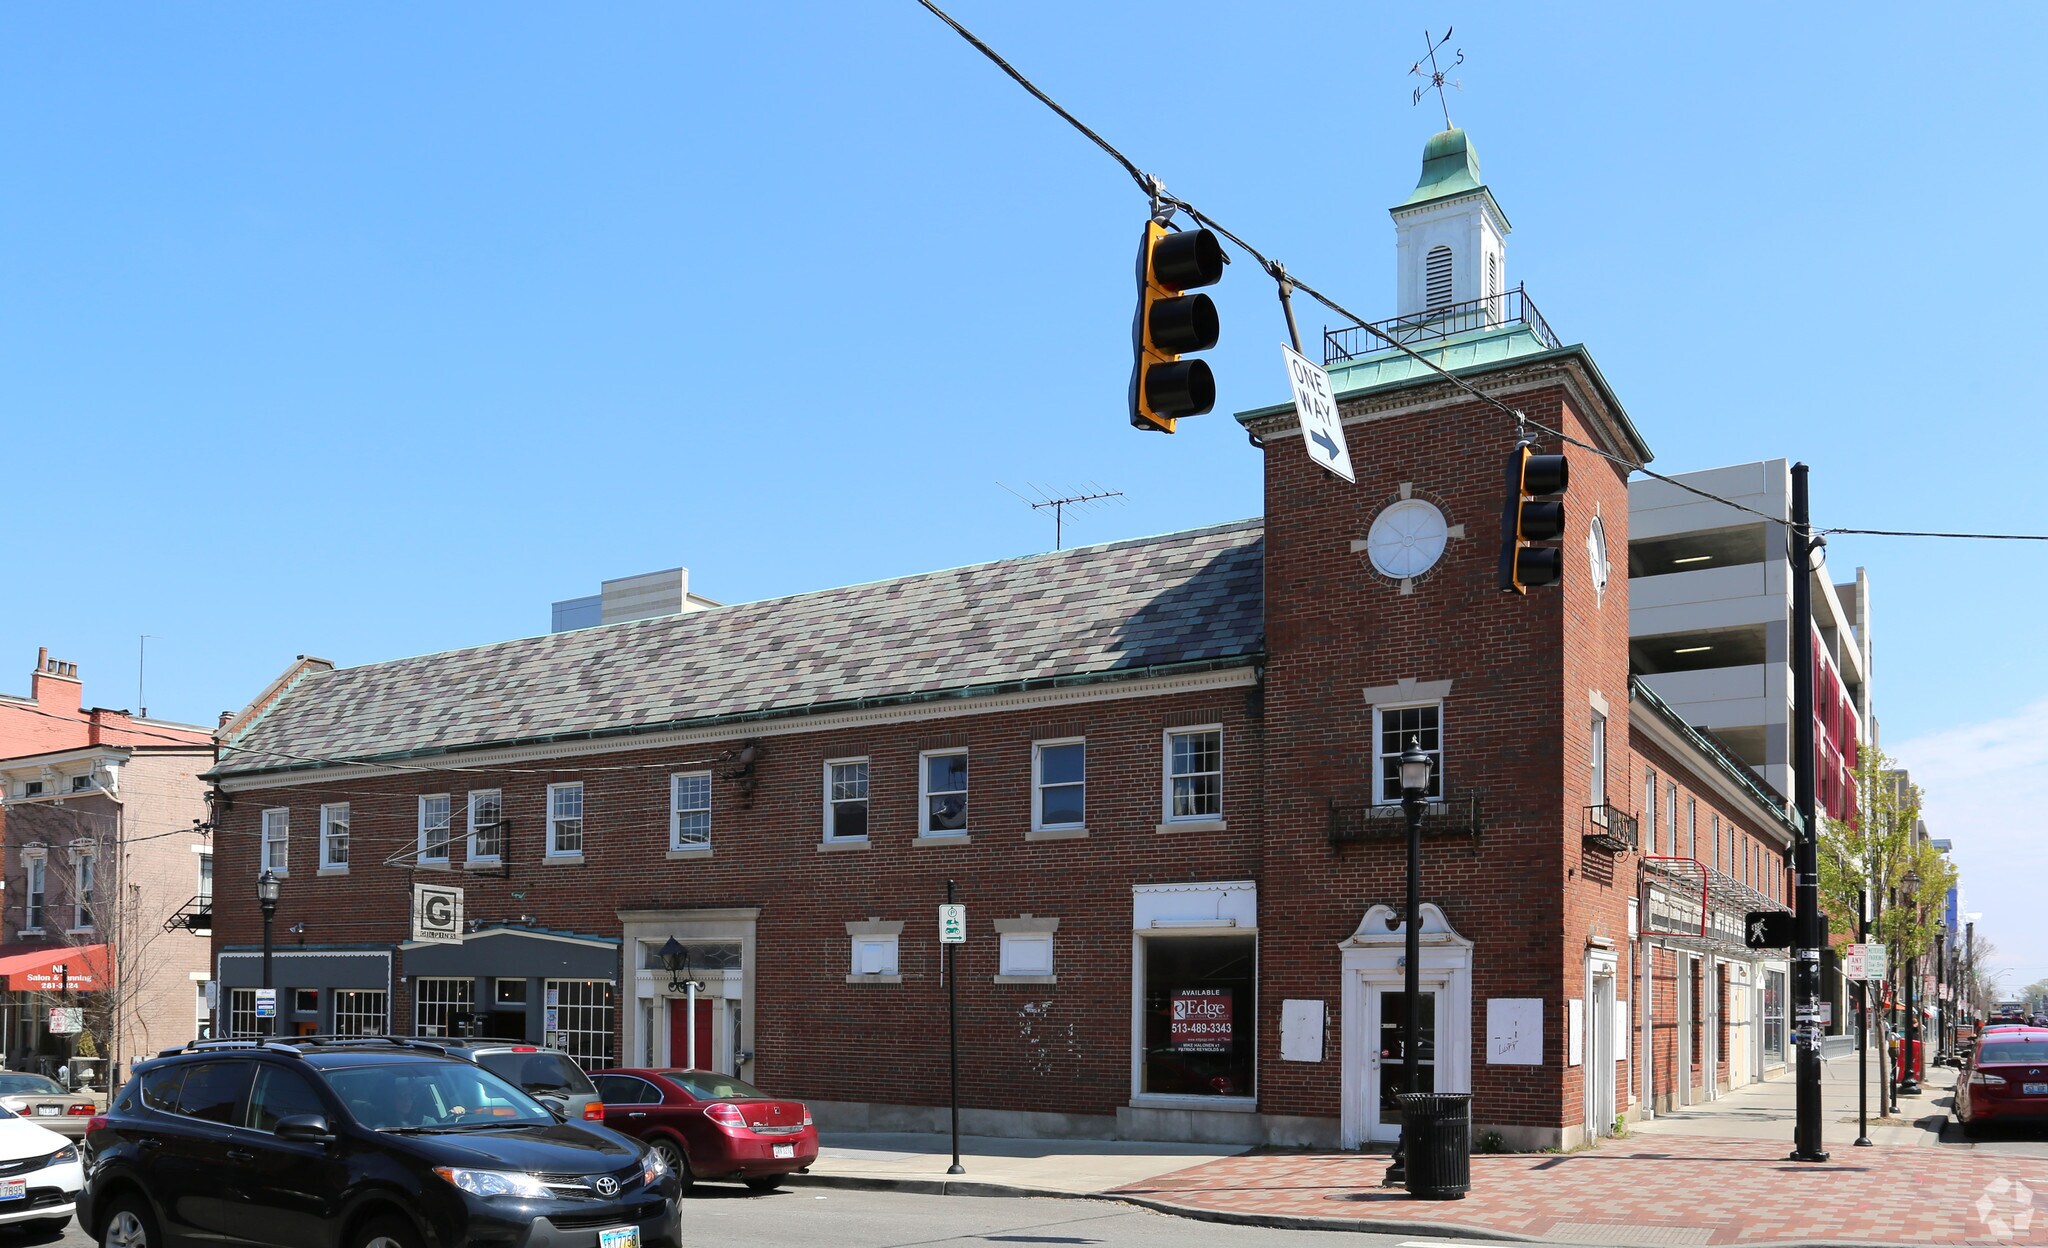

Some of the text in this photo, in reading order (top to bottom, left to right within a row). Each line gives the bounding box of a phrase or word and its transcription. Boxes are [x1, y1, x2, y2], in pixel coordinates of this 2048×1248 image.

[1293, 359, 1326, 398] ONE
[1298, 388, 1331, 427] WAY
[426, 896, 451, 926] G
[27, 973, 51, 982] Salon
[53, 974, 60, 982] &
[1186, 1000, 1225, 1019] Edge
[1171, 1023, 1232, 1033] 513-489-3343
